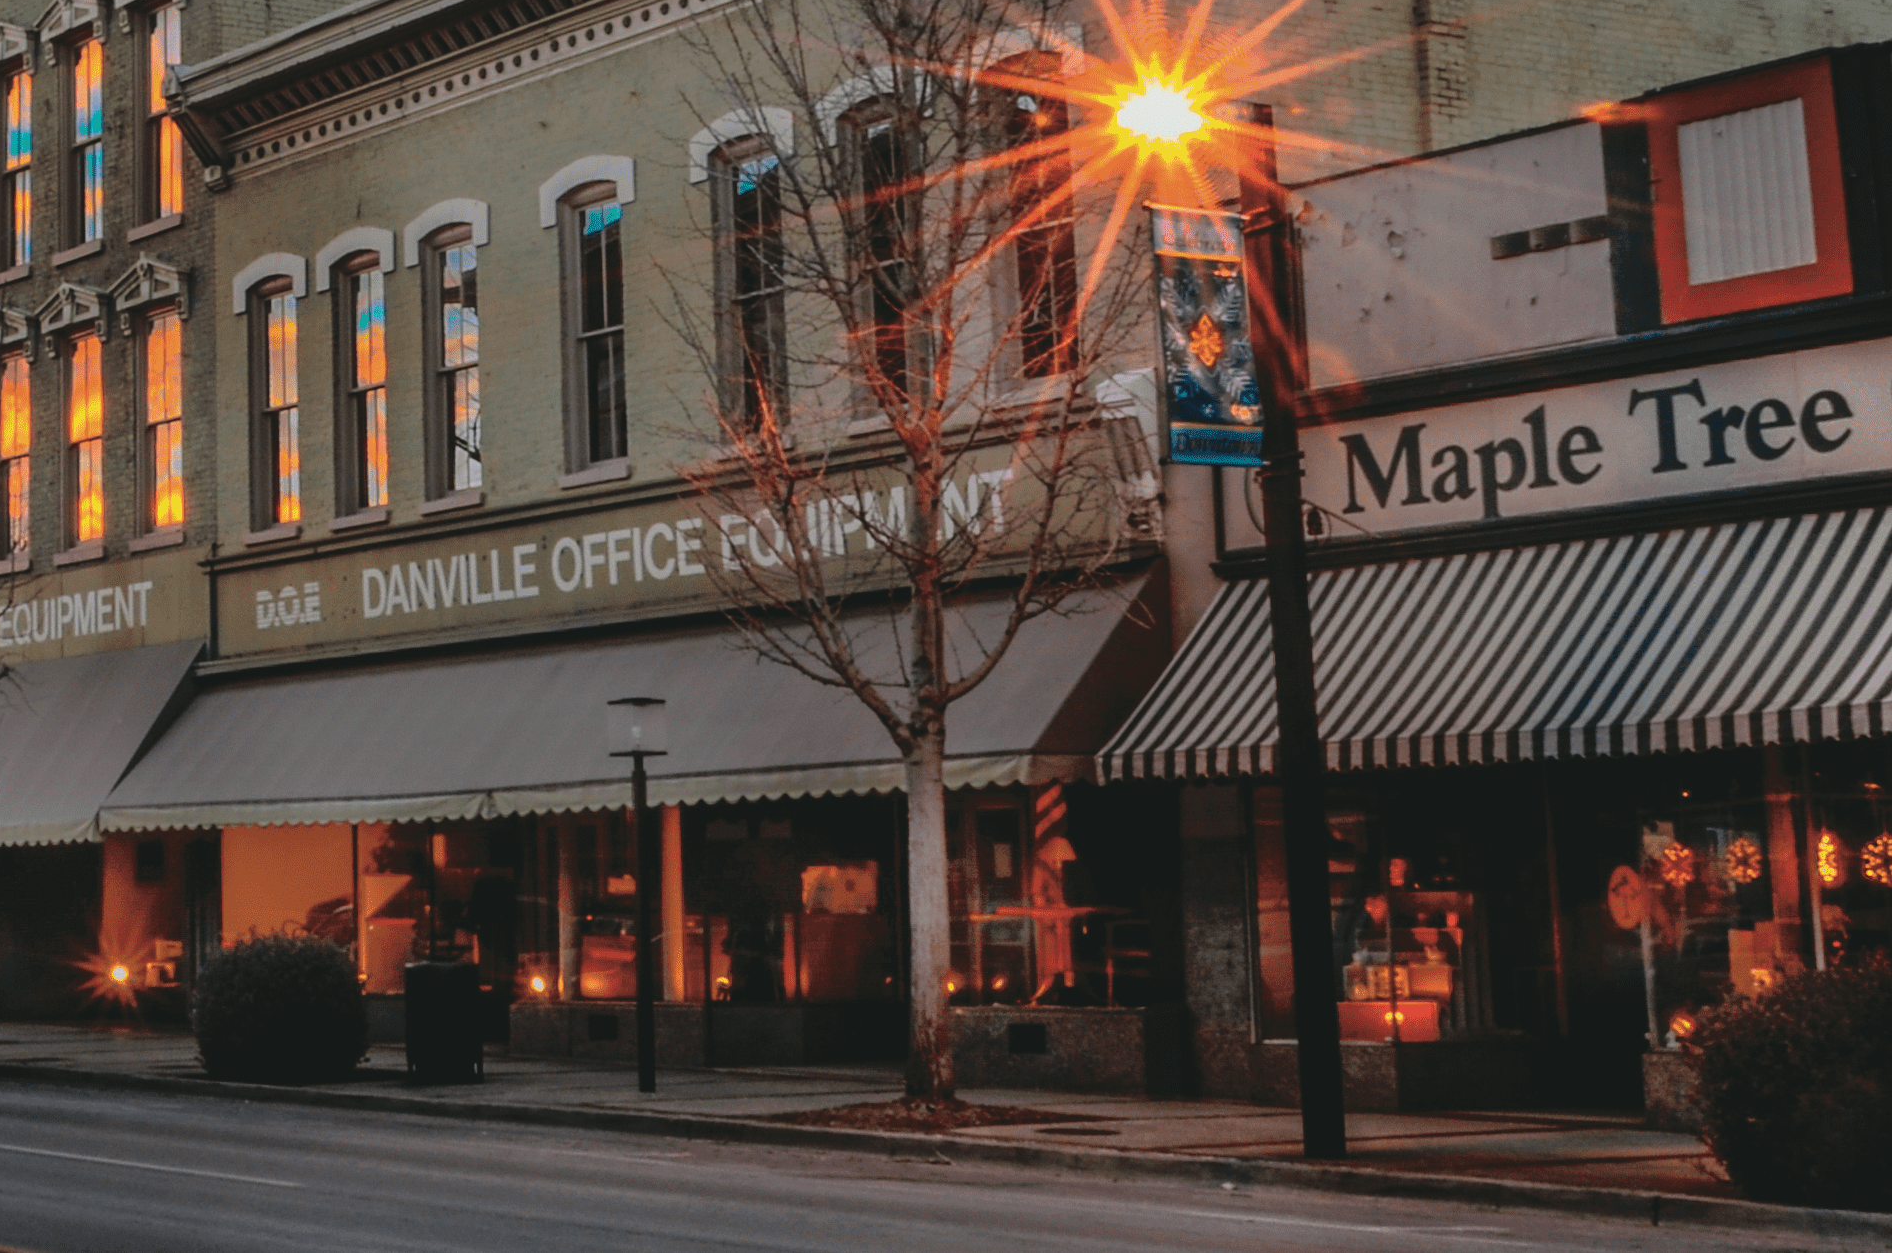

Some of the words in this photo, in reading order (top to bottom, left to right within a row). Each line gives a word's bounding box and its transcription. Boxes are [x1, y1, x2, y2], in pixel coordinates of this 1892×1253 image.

[1339, 403, 1604, 519] Maple
[1627, 377, 1854, 474] Tree
[361, 543, 540, 619] DANVILLE
[551, 518, 706, 593] OFFICE
[719, 468, 1014, 572] EQUIPMNT
